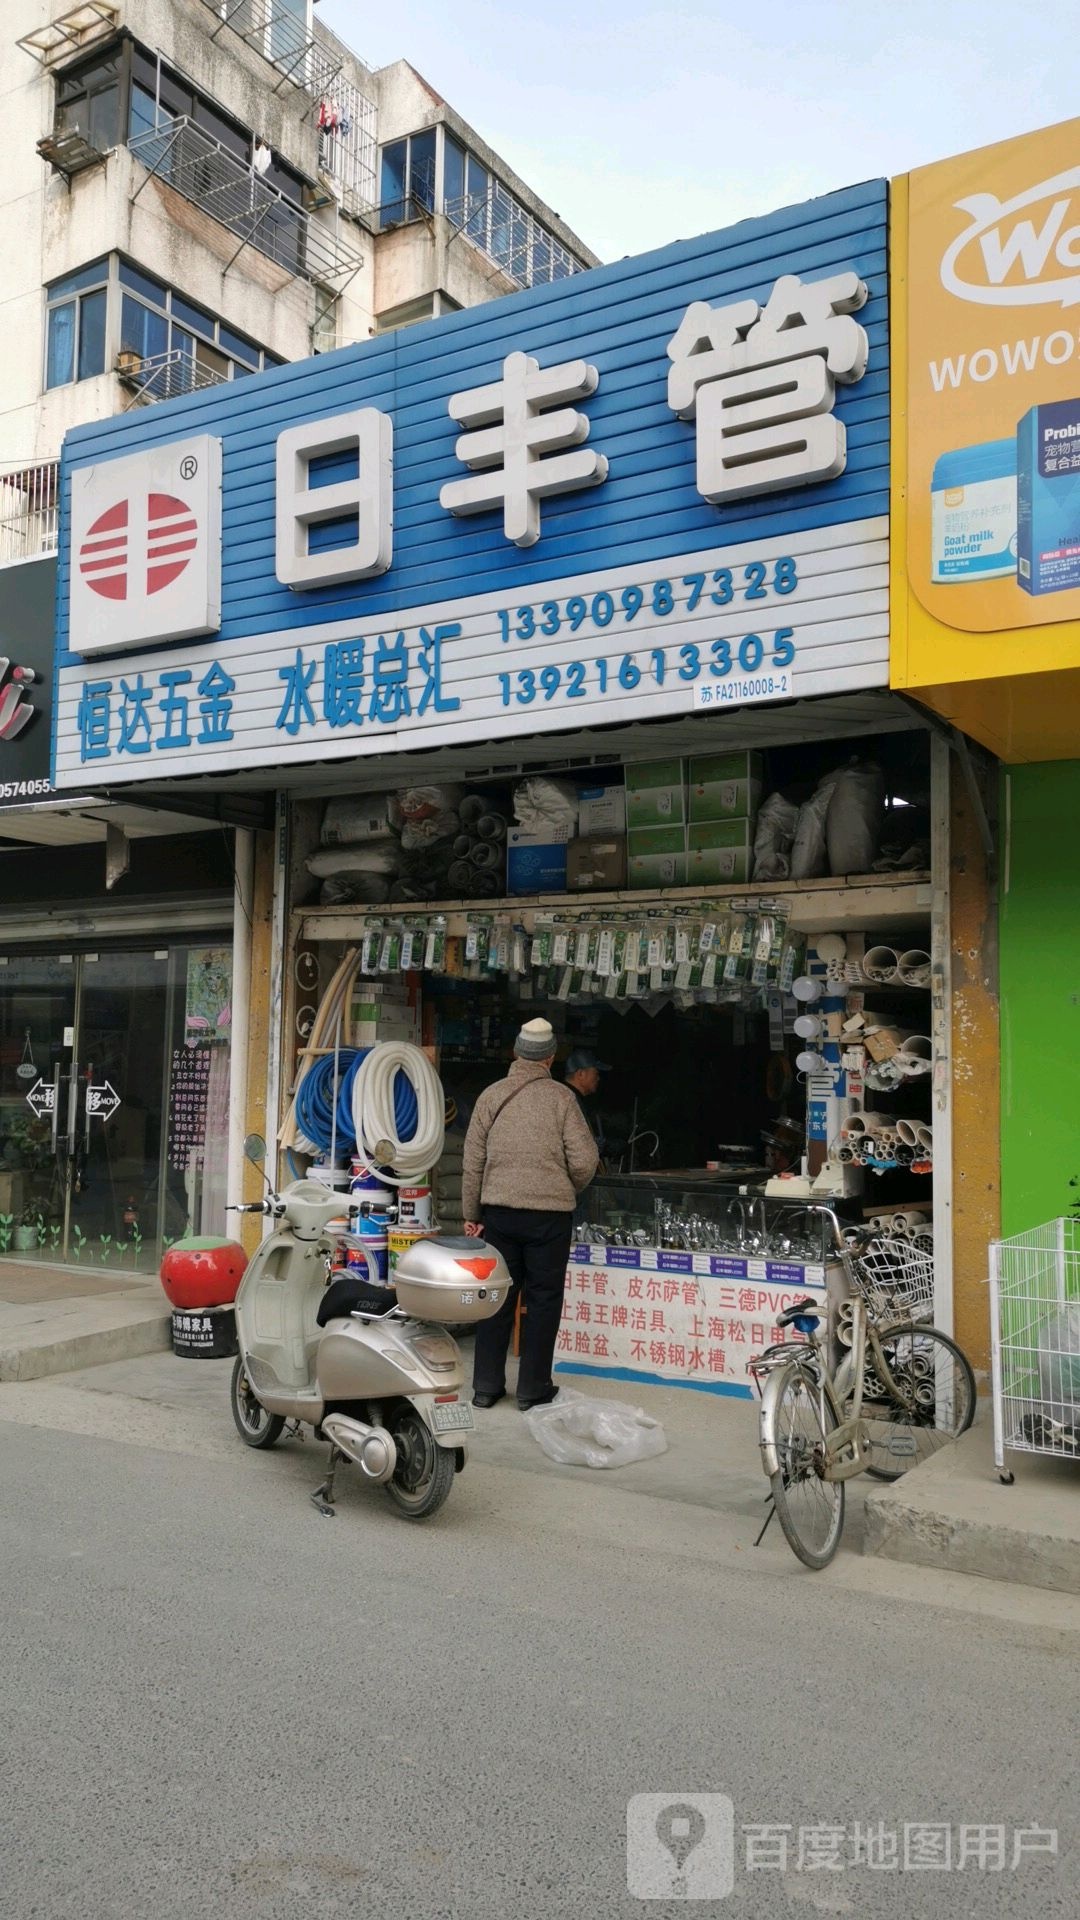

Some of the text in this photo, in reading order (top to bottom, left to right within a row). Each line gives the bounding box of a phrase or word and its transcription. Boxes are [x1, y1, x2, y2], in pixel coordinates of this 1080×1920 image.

[928, 329, 1080, 392] WOWO
[275, 274, 869, 594] 日丰管
[944, 530, 994, 546] Goat milk
[944, 544, 982, 557] powder
[498, 556, 798, 643] 13390987328
[498, 628, 796, 707] 13921613305
[700, 675, 788, 702] 苏 FA21160008-2
[77, 661, 236, 763] 恒达五金
[275, 623, 463, 735] 水暖总汇
[0, 778, 56, 798] 0574055
[391, 1237, 417, 1246] MISTE
